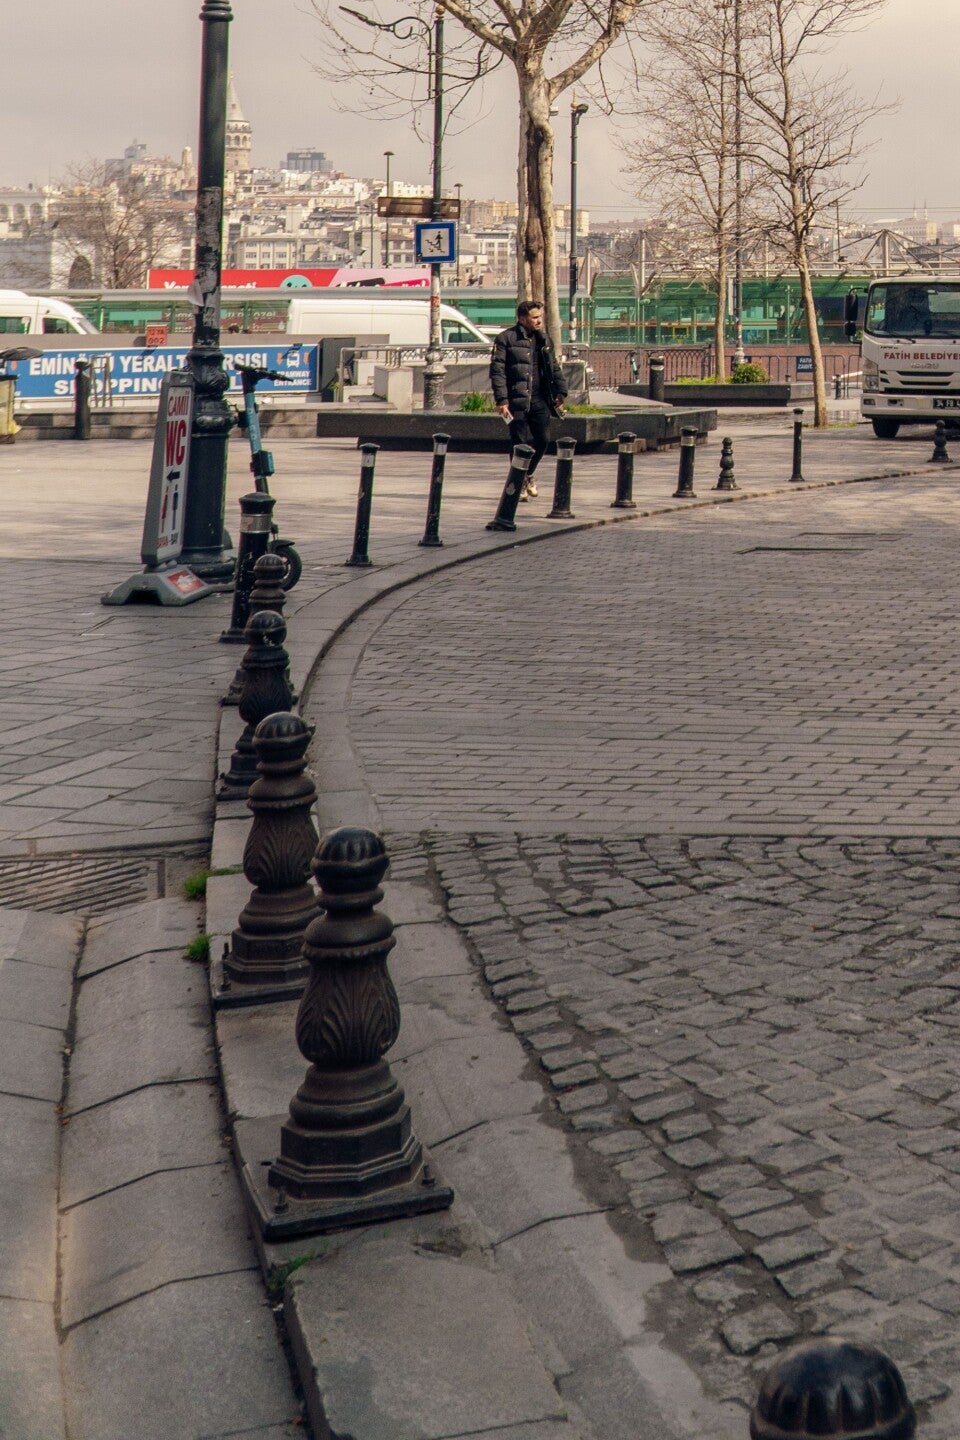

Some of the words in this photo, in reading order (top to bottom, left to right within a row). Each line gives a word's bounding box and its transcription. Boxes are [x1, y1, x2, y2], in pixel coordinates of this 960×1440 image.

[119, 353, 187, 373] YERALT
[884, 351, 911, 360] FATİH
[166, 419, 187, 467] WC
